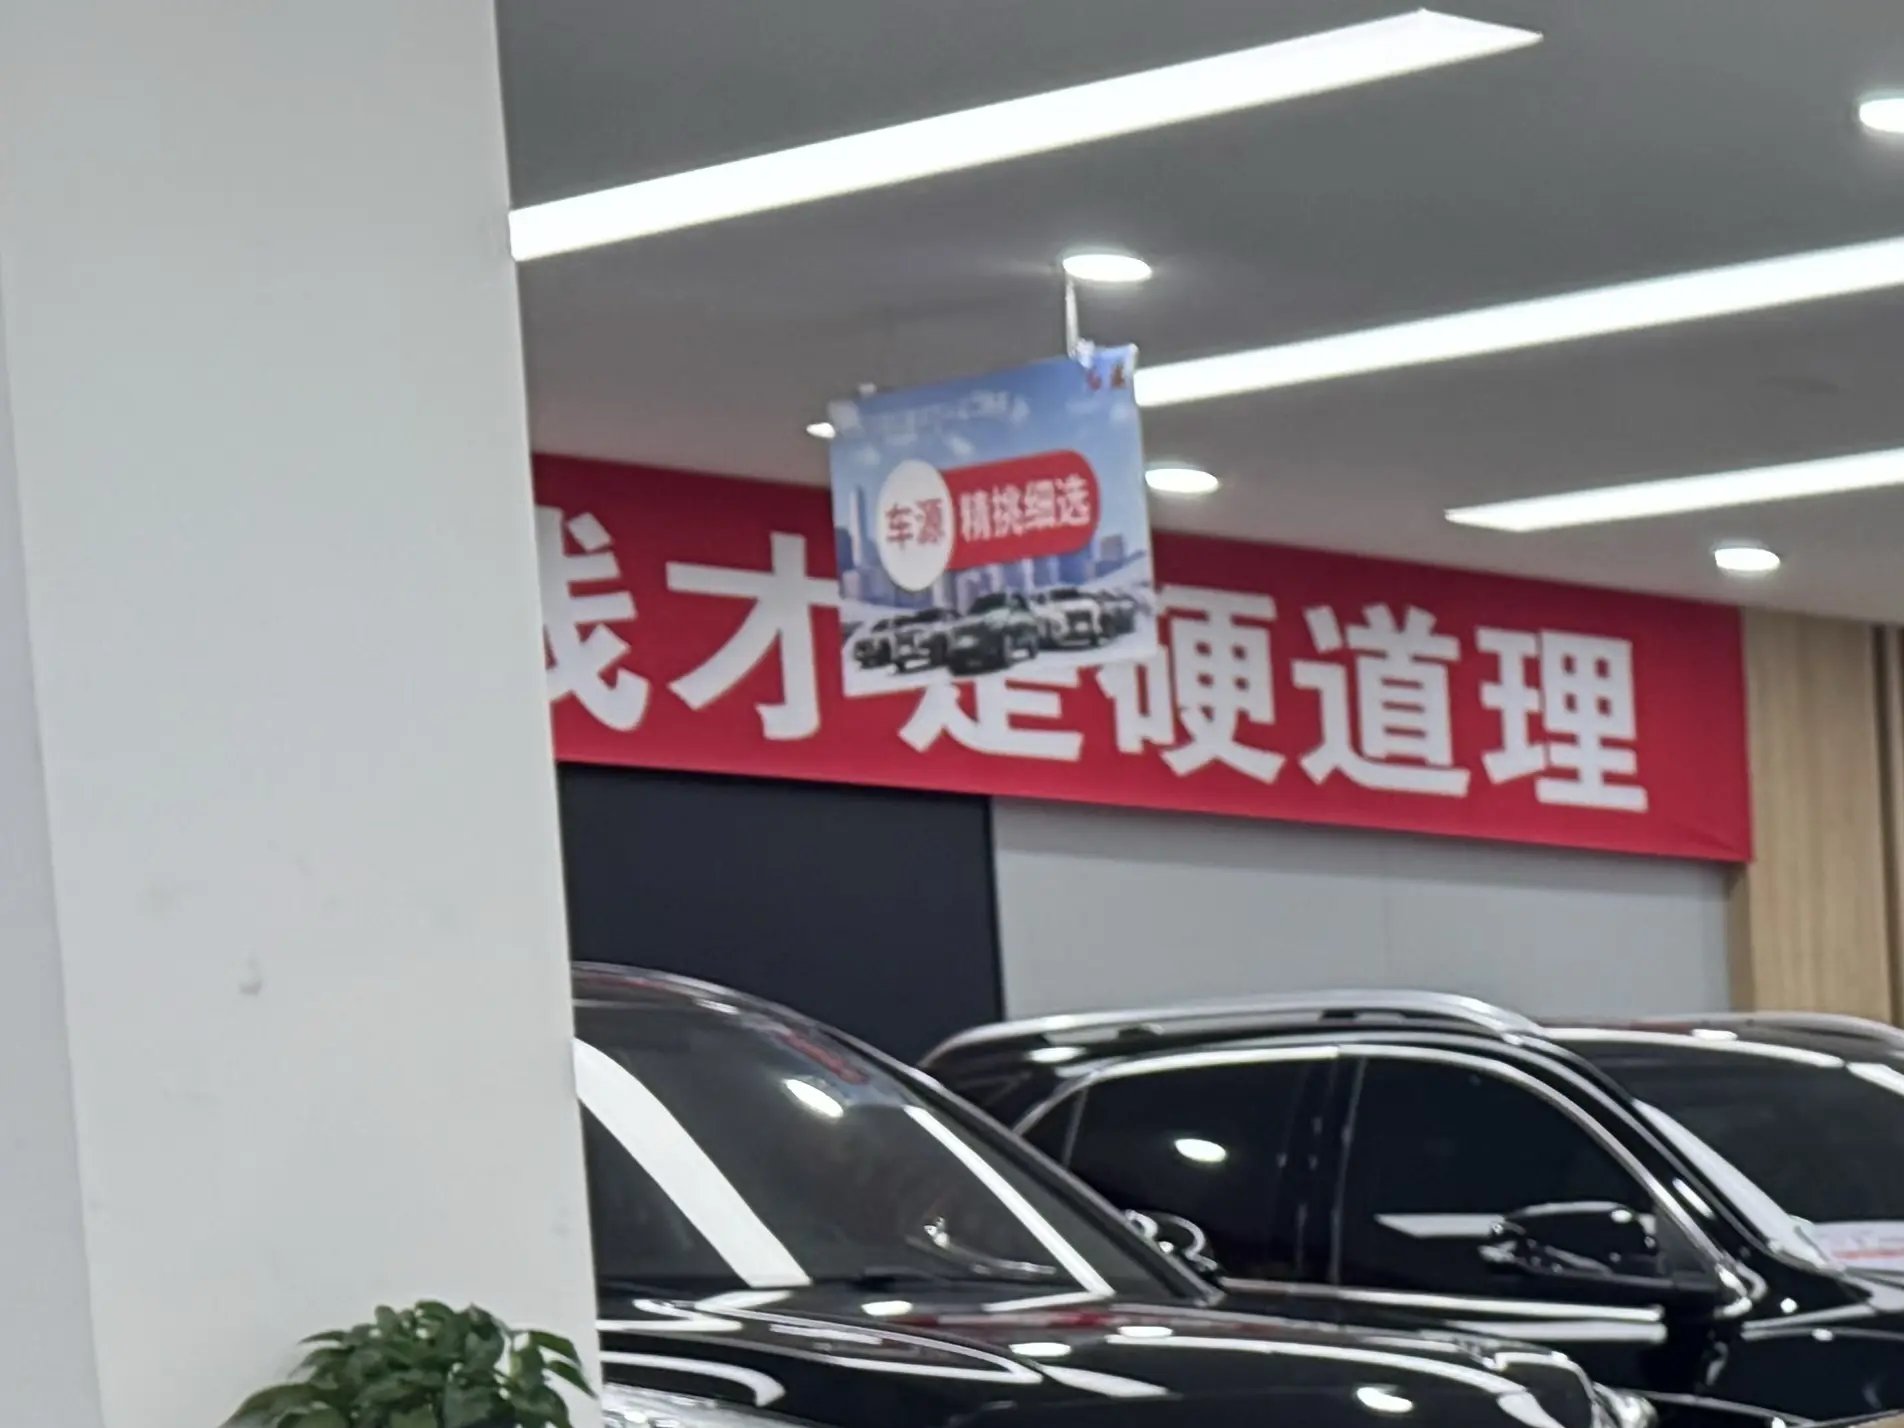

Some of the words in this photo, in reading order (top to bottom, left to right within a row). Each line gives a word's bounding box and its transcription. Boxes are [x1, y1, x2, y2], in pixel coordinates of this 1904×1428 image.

[884, 497, 945, 552] 车源
[959, 474, 1091, 543] 精挑细选
